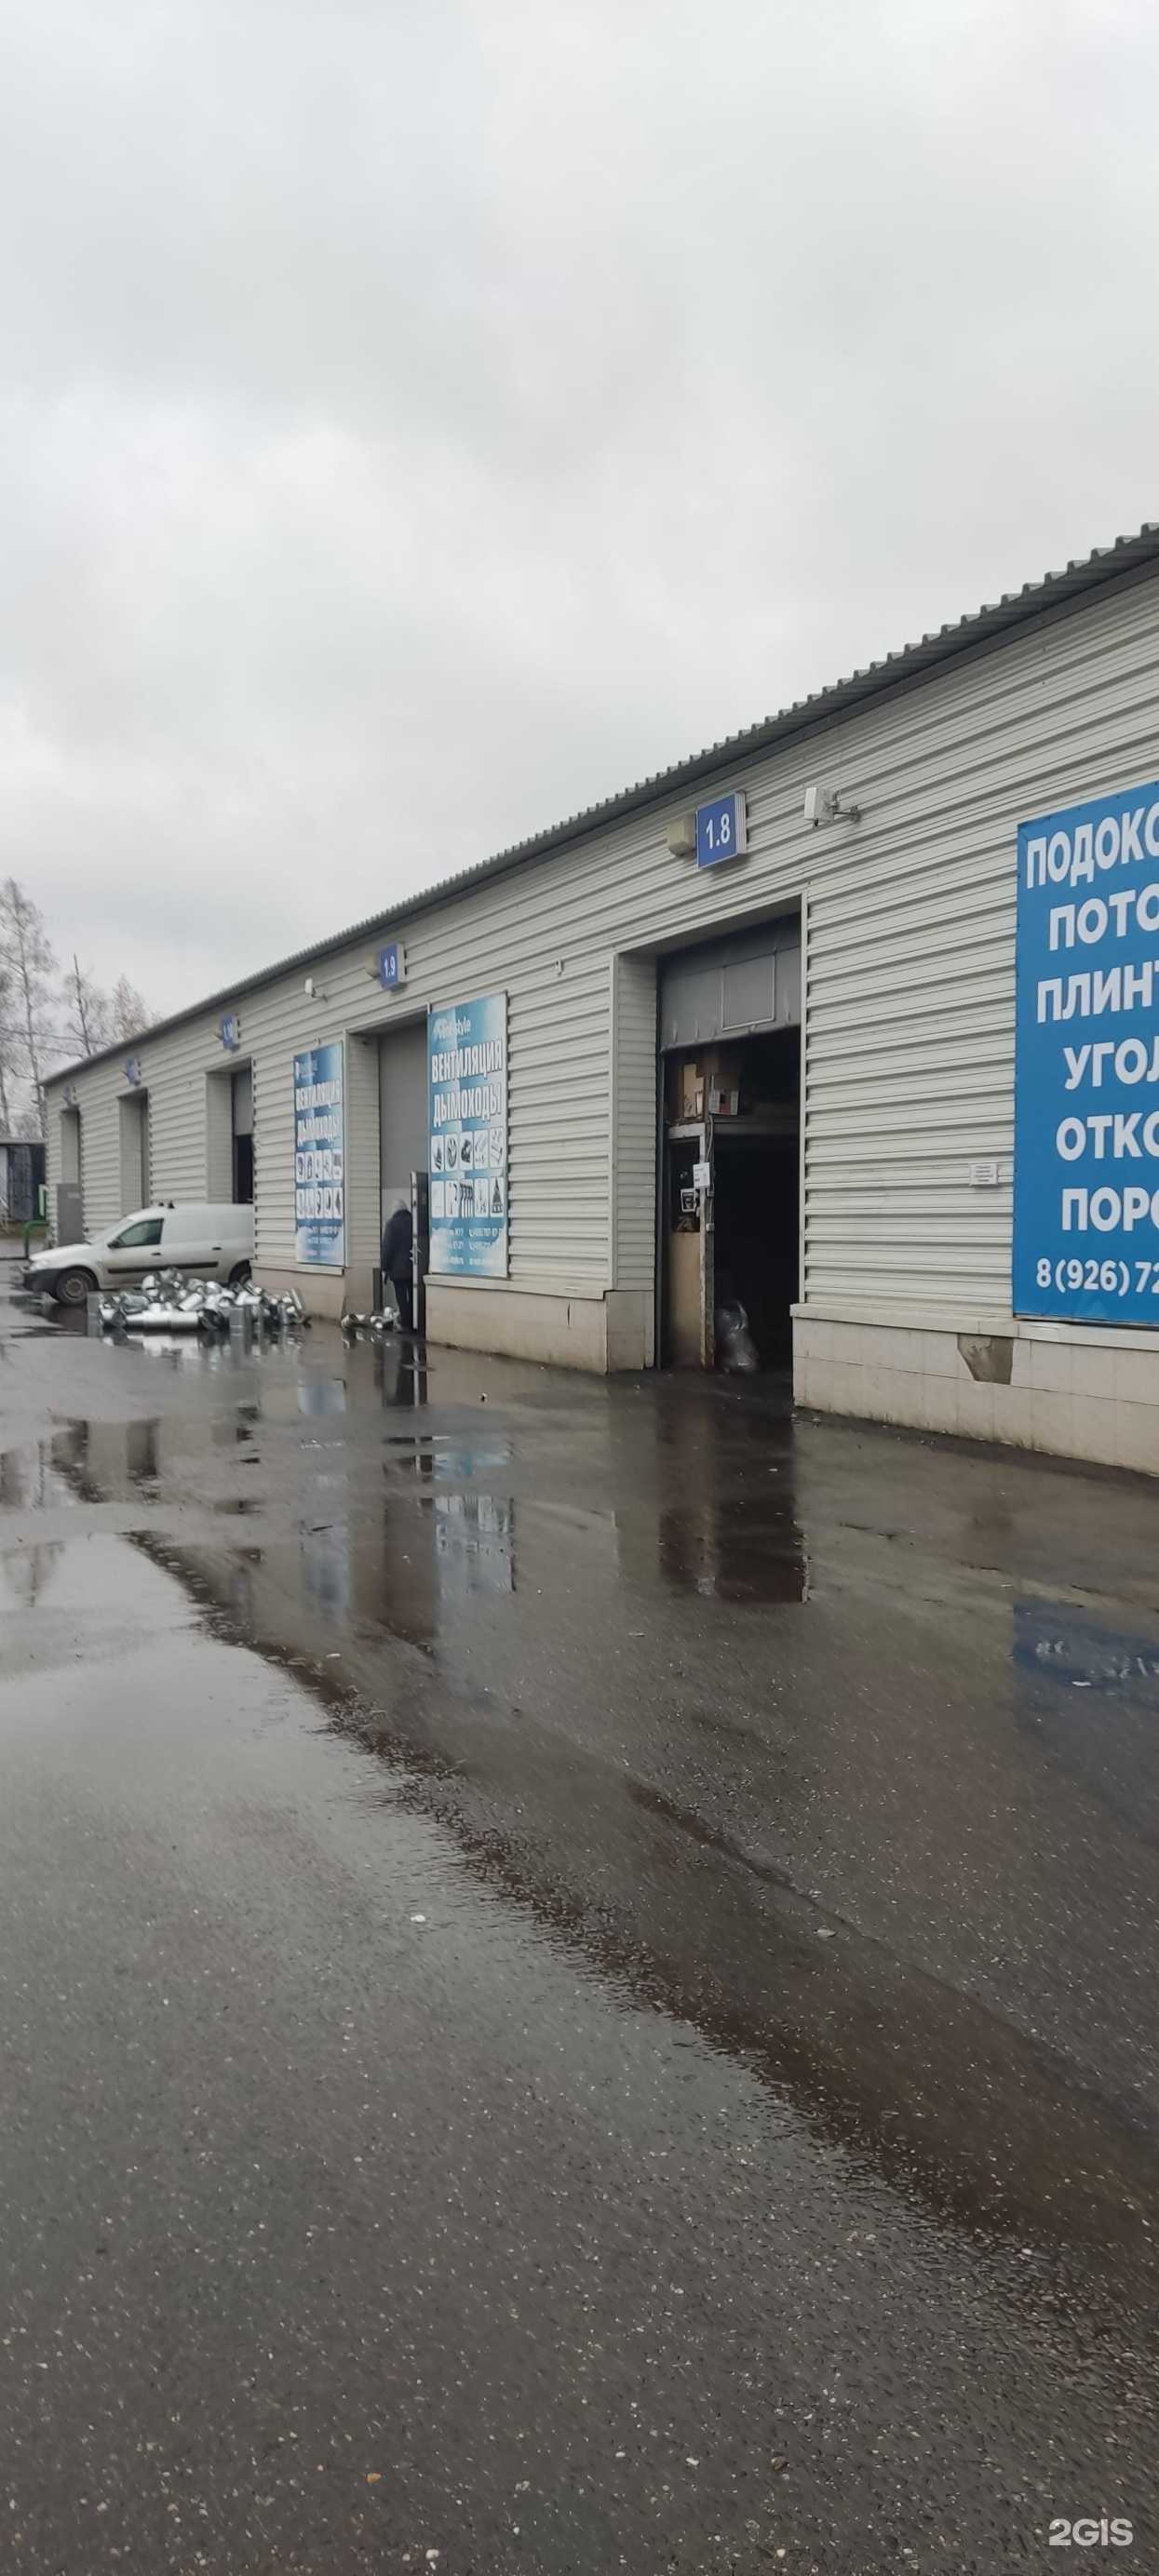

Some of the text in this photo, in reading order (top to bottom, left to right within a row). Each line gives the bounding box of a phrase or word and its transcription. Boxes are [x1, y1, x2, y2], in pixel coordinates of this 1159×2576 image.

[706, 812, 731, 850] 1.8
[1049, 883, 1159, 951] ПОТО
[384, 955, 396, 978] 1.9
[1037, 959, 1159, 1024] ПЛИН
[431, 1039, 503, 1084] ВЕНТИЛЯЦИЯ
[433, 1082, 503, 1128] ДЫМОХОДЫ
[1061, 1186, 1159, 1232] ПОР
